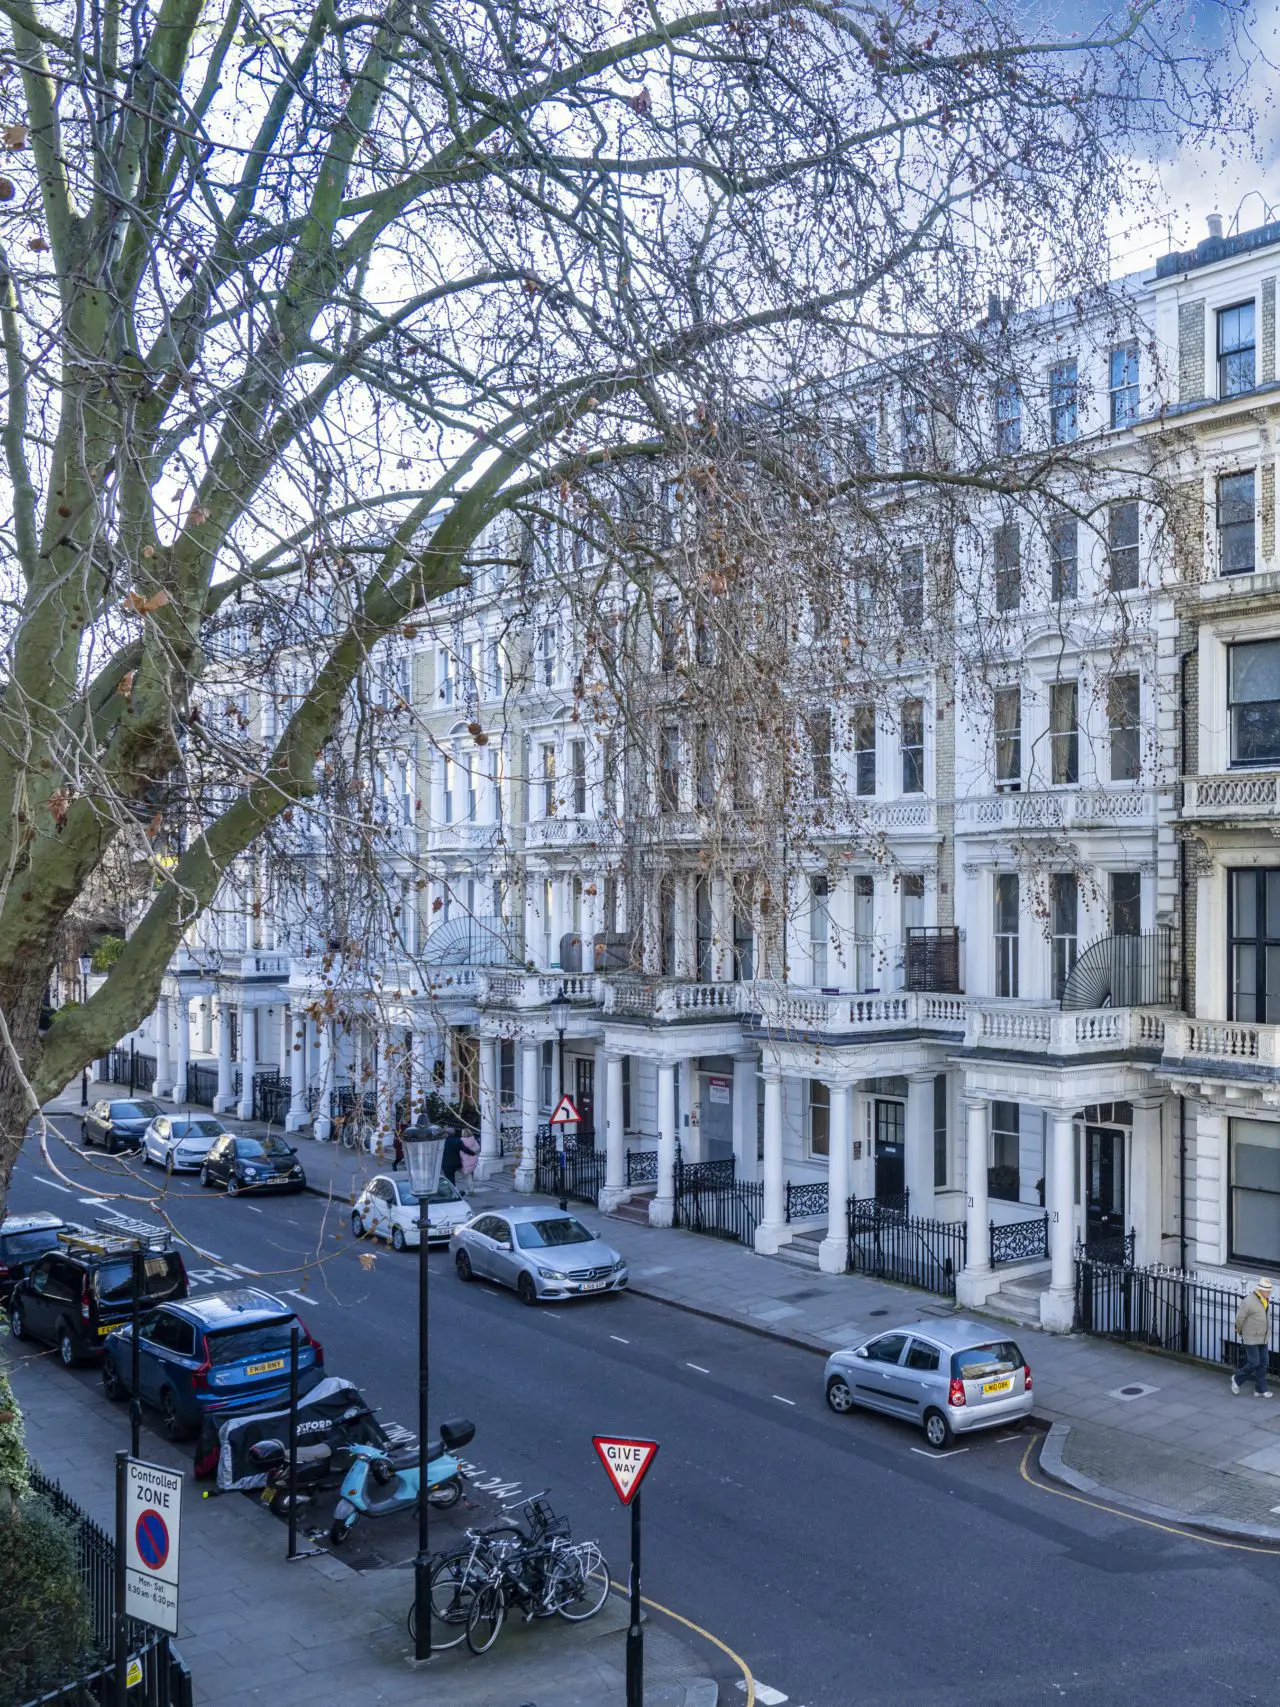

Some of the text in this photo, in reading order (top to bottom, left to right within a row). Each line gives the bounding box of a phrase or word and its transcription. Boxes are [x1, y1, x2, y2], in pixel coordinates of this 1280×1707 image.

[968, 1196, 974, 1208] 21
[1053, 1211, 1059, 1223] 21
[607, 1446, 641, 1461] GIVE
[614, 1463, 636, 1473] WAY
[131, 1467, 178, 1491] Controlled
[137, 1485, 170, 1508] ZONE
[154, 1583, 164, 1593] Sat
[127, 1583, 140, 1595] 8.30
[166, 1600, 176, 1609] pm
